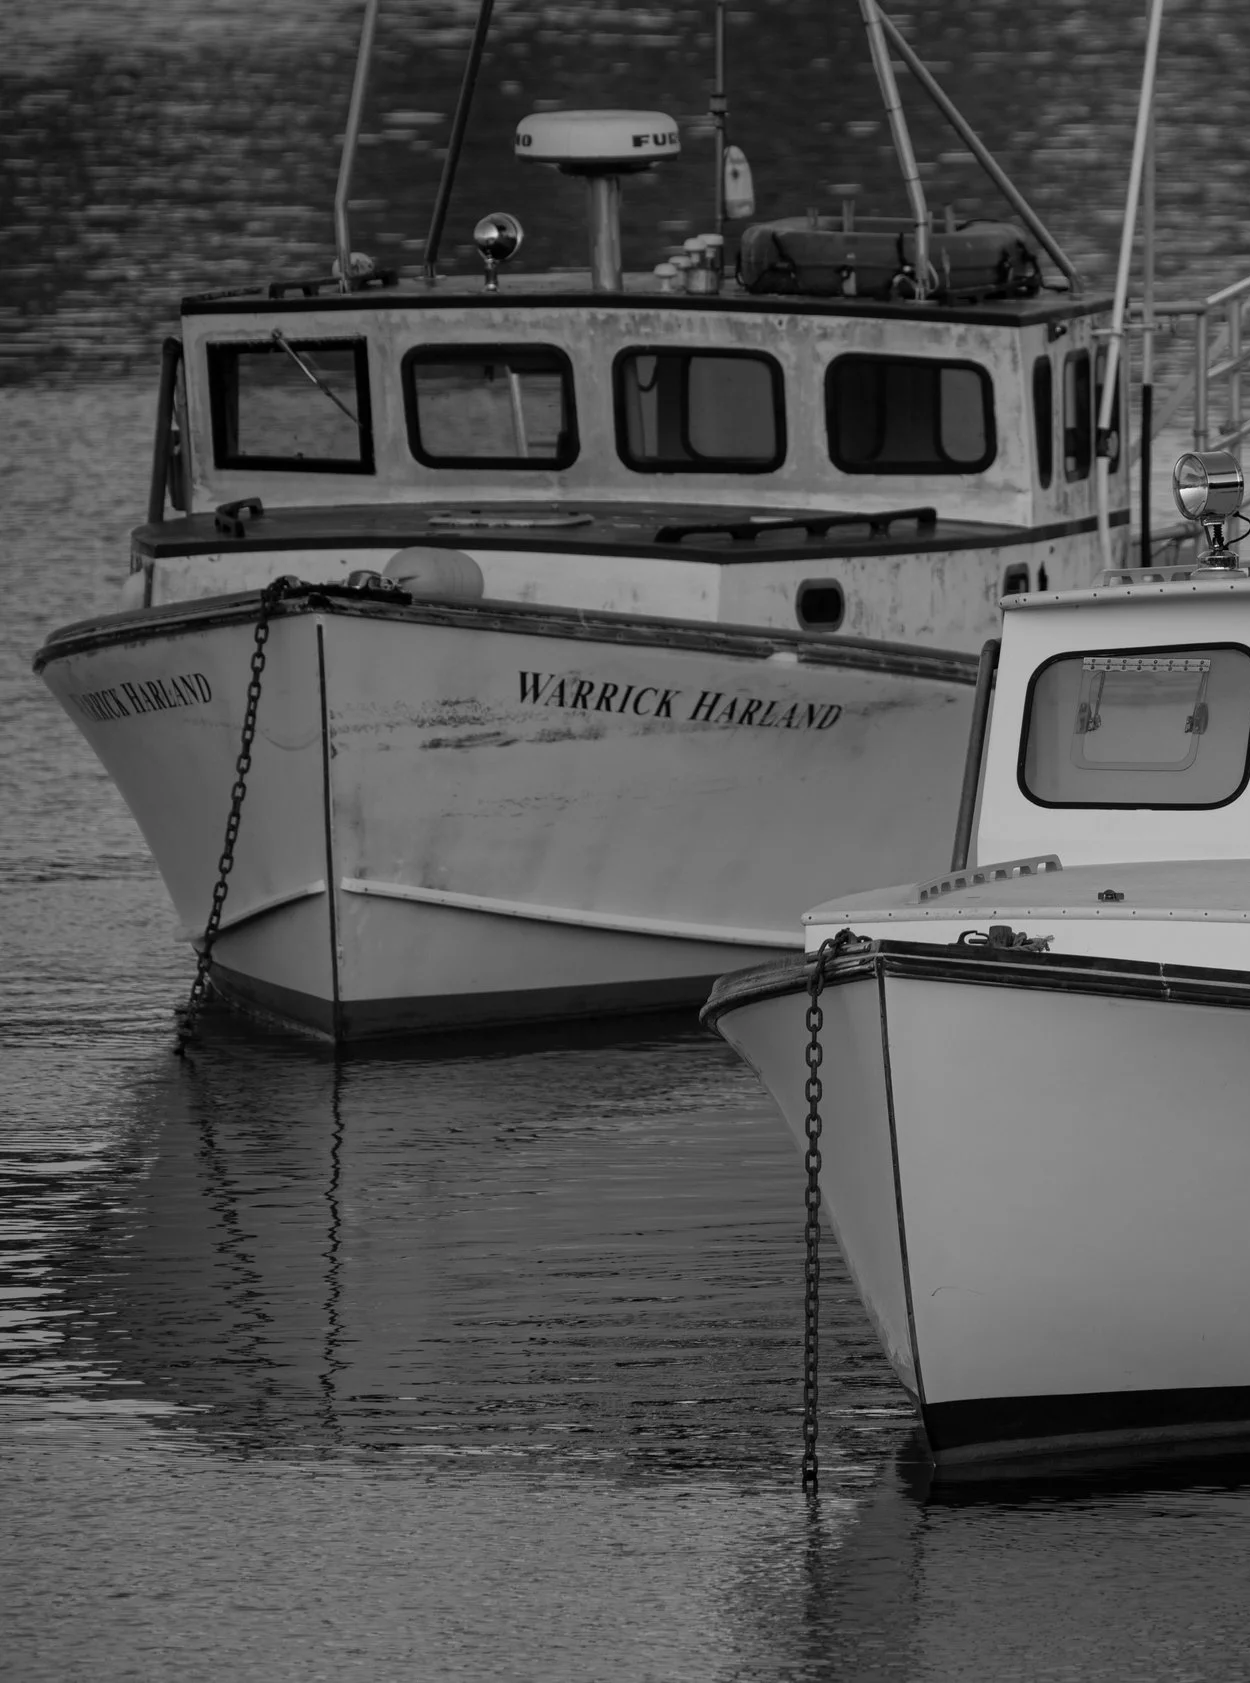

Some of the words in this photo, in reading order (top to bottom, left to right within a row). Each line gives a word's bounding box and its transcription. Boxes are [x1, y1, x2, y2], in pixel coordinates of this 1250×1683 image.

[69, 688, 131, 722] RRICK
[120, 673, 212, 714] HARLAND
[518, 671, 682, 718] WARRICK
[687, 690, 843, 730] HARLAND
